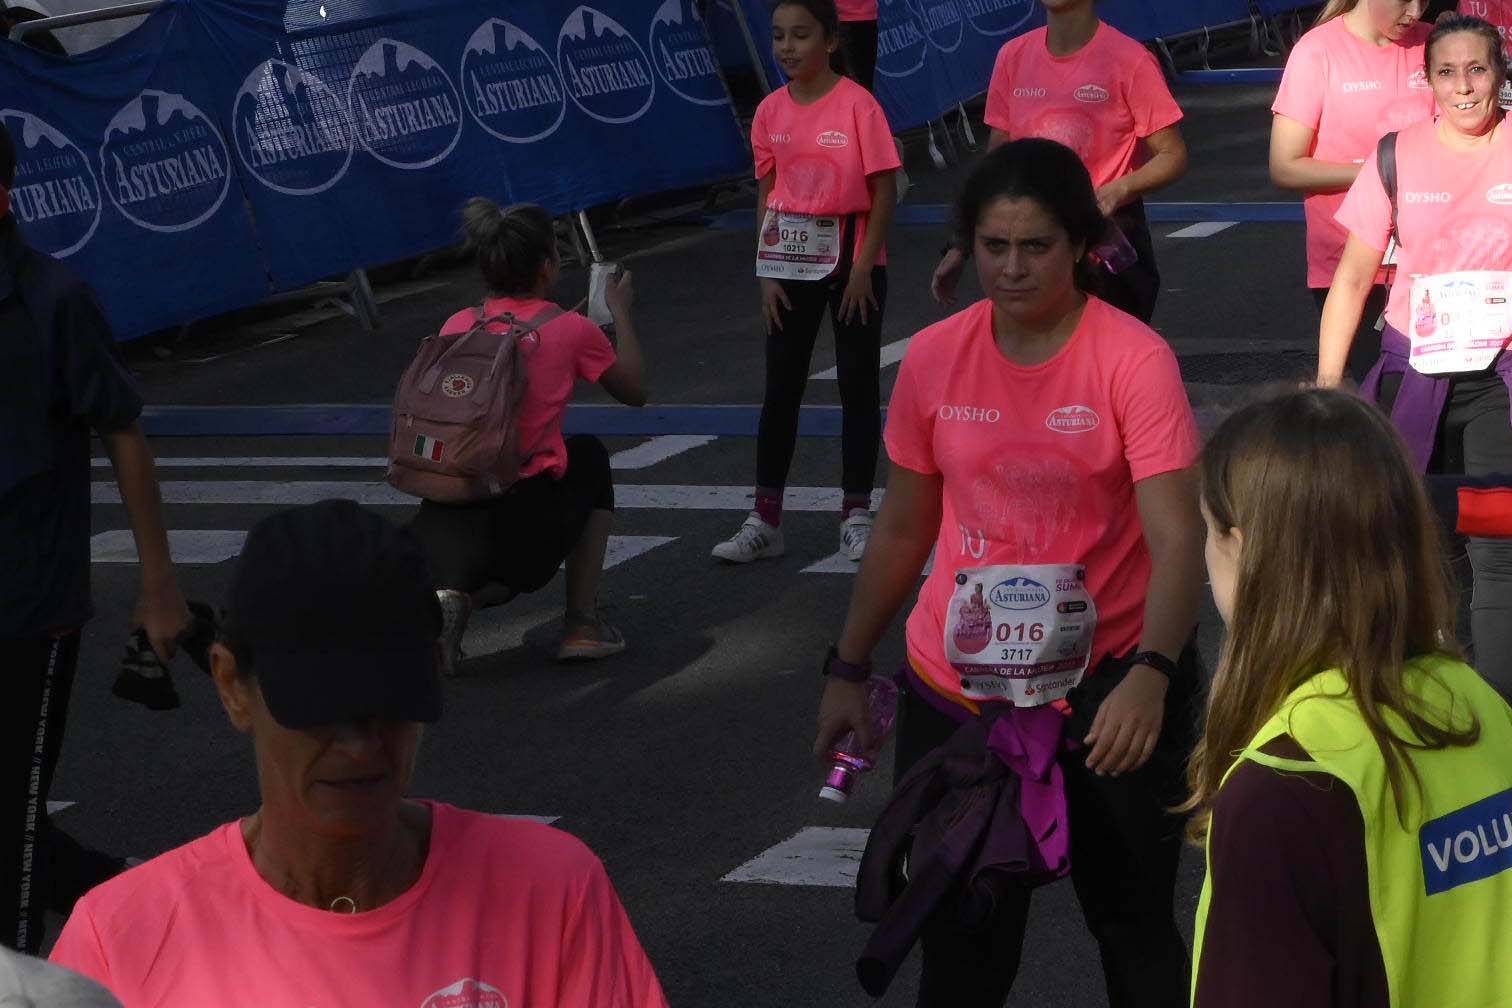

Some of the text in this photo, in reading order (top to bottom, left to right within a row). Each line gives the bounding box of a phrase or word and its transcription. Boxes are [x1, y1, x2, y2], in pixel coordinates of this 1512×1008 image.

[566, 53, 650, 98] ASTURIANA
[659, 39, 715, 82] ASTUR
[470, 68, 562, 118] ASTURIANA
[359, 92, 458, 142] ASTURIANA
[246, 114, 354, 167] ASTURIANA
[116, 144, 224, 204] ASTURIANA
[10, 176, 96, 224] TURIANA
[1406, 192, 1451, 204] OYSHO
[782, 229, 808, 242] 016
[783, 244, 806, 253] 10213
[939, 405, 1000, 423] OYSHO
[995, 589, 1046, 603] ASTURIANA
[996, 622, 1044, 642] 016
[1001, 649, 1032, 661] 3717
[34, 720, 46, 753] YORK
[29, 766, 40, 795] NEW
[26, 796, 38, 832] YORK
[22, 843, 33, 871] NEW
